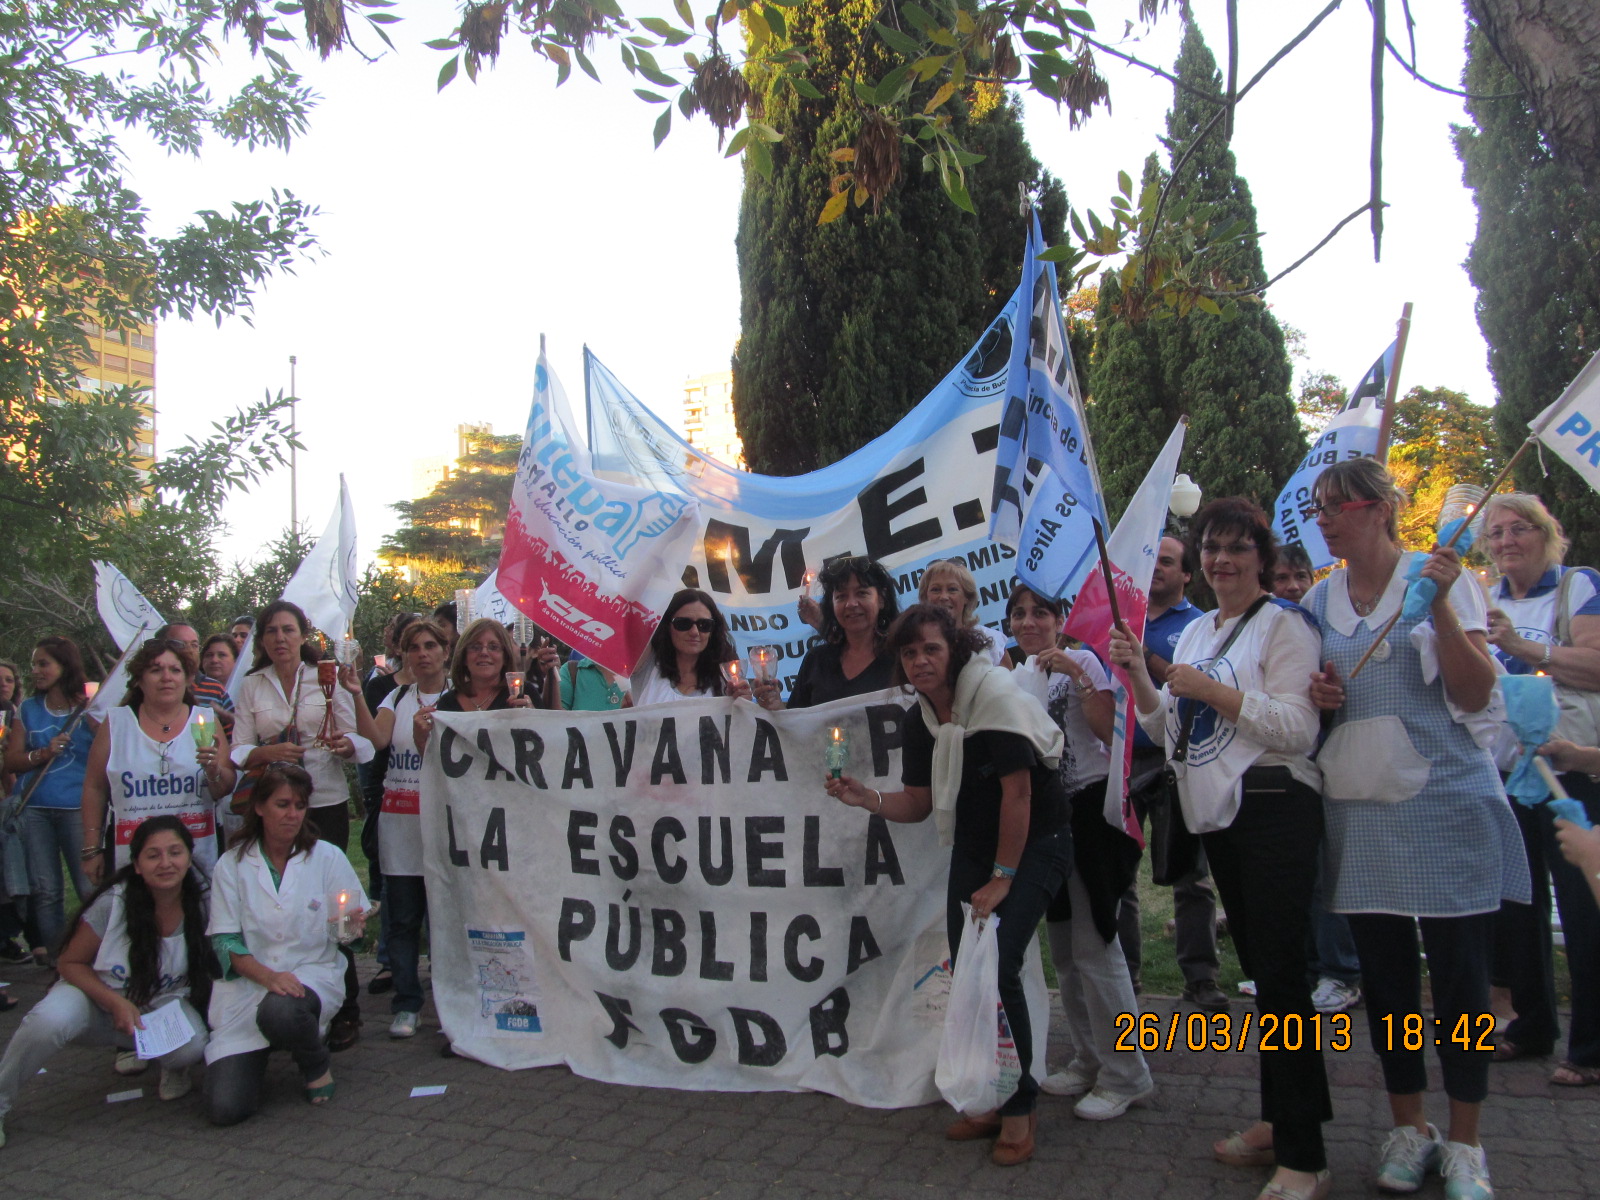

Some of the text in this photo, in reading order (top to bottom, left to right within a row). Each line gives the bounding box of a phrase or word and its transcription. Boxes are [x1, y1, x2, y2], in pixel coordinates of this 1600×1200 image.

[1060, 427, 1077, 454] de
[541, 607, 602, 648] de los trabajadores
[440, 715, 788, 789] CARAVANA
[446, 804, 905, 888] LA ESCUELA
[558, 889, 882, 982] PÚBLICA
